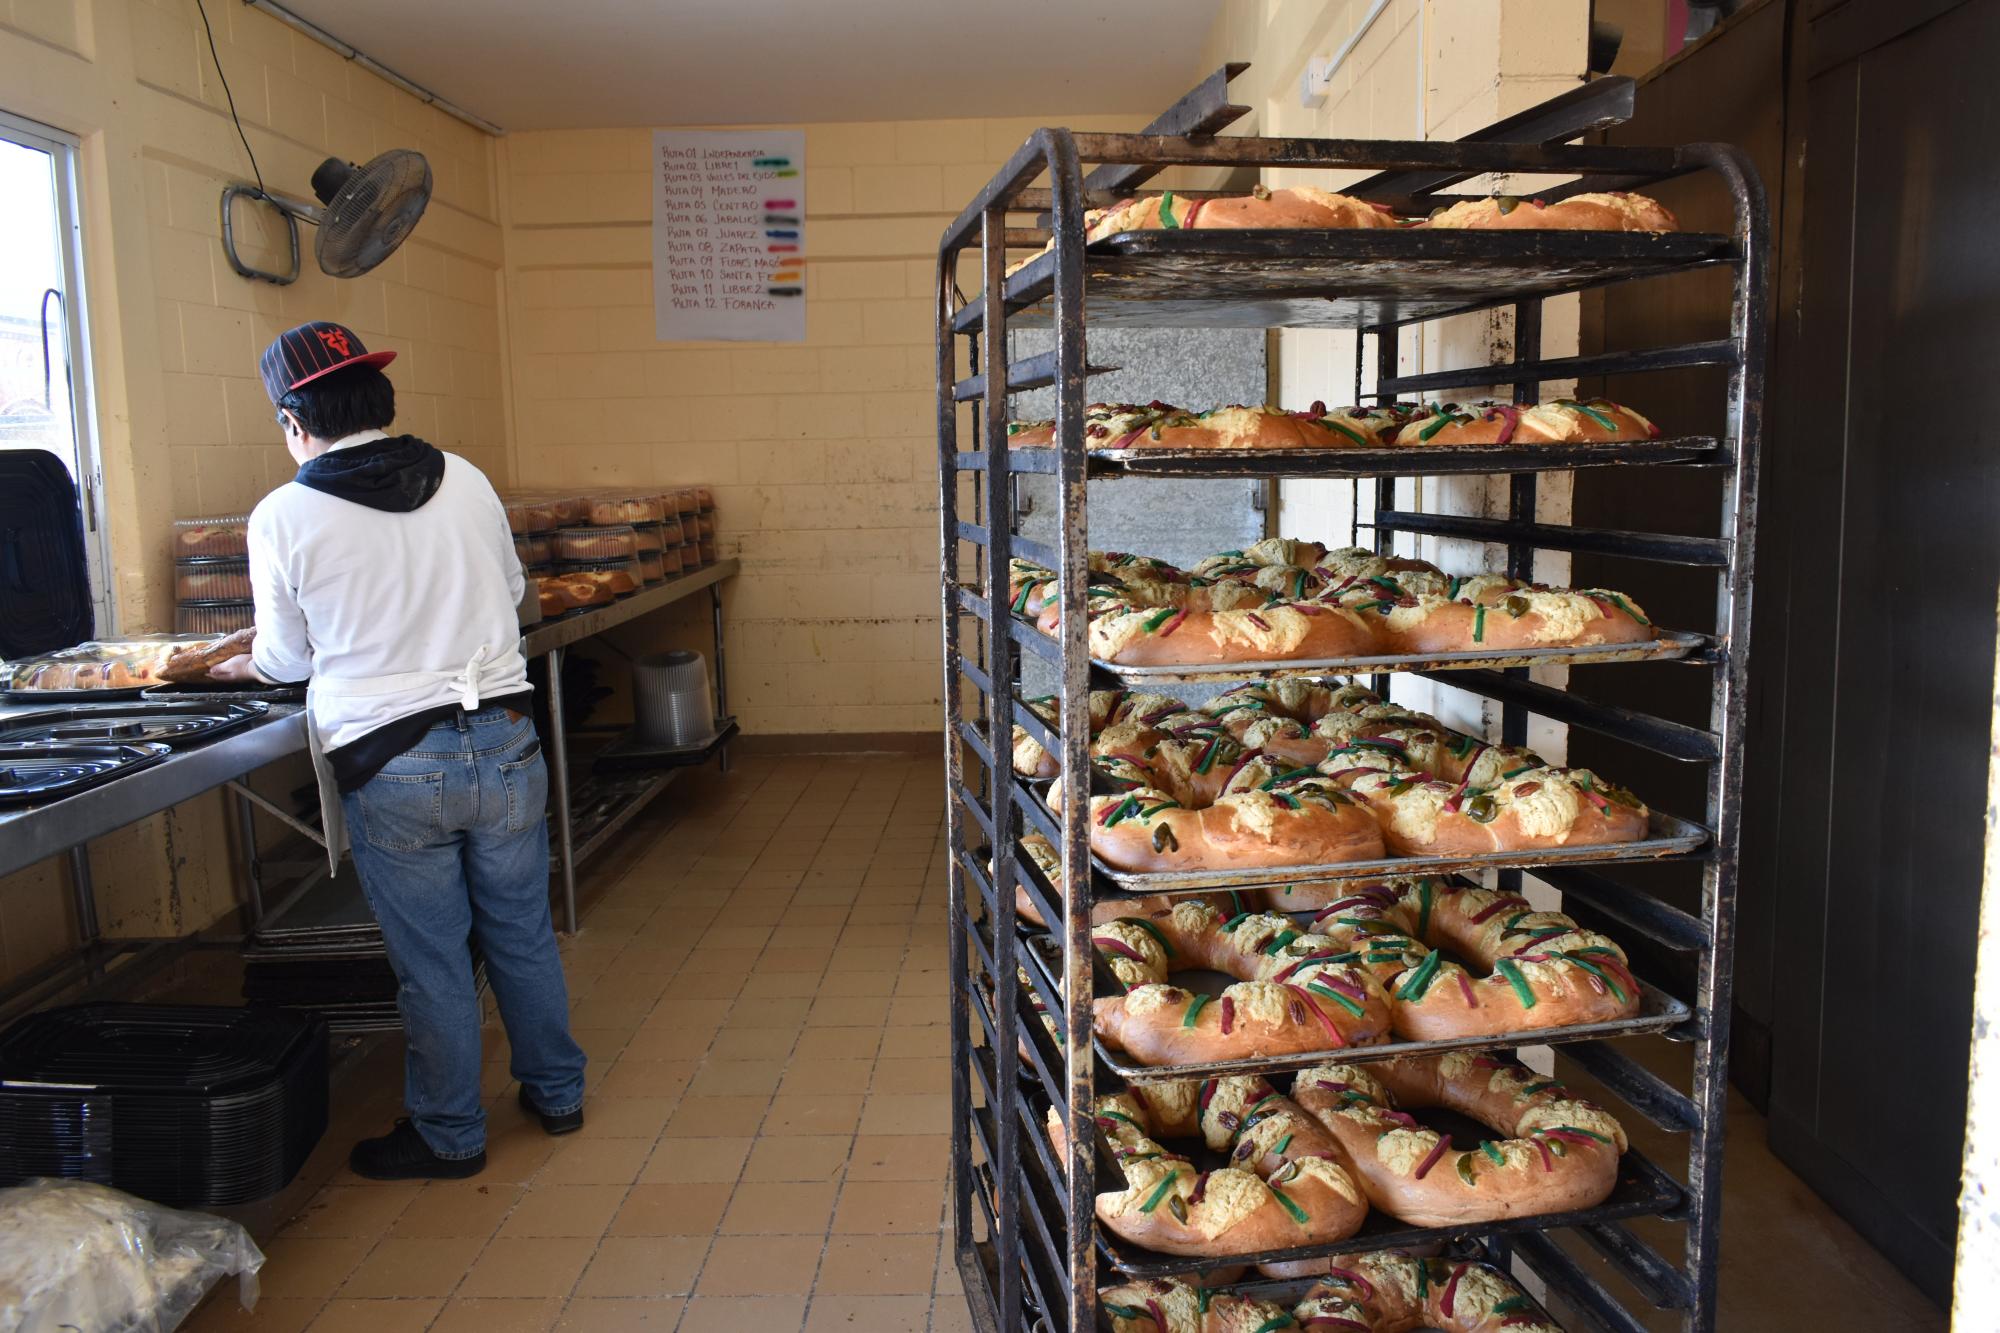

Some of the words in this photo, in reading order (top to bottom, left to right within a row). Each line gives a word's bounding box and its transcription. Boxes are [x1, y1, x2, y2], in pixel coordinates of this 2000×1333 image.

[663, 146, 684, 156] RUTA
[686, 148, 696, 158] 01
[664, 162, 685, 170] RUTA
[686, 162, 698, 170] 02
[664, 173, 688, 183] RUTA
[690, 174, 702, 182] 03
[665, 186, 688, 196] RUTA
[690, 186, 702, 198] 04
[712, 185, 757, 196] MADERO
[666, 200, 691, 210] RUTA
[694, 200, 706, 210] 05
[713, 199, 759, 210] CENTRO
[667, 213, 690, 223] RUTA
[668, 228, 692, 238] RUTA
[716, 228, 758, 238] JUAREZ
[668, 242, 694, 252] RUTA
[698, 242, 713, 252] 08
[720, 242, 762, 254] ZAPATA
[670, 256, 696, 266] RUTA
[700, 256, 713, 266] 09
[720, 256, 751, 267] FLORES
[670, 270, 696, 280] RUTA
[701, 269, 714, 280] 10
[720, 270, 752, 280] SANTA
[671, 284, 698, 294] RUTA
[704, 284, 713, 295] 11
[672, 297, 700, 308] RUTA
[705, 298, 718, 308] 12
